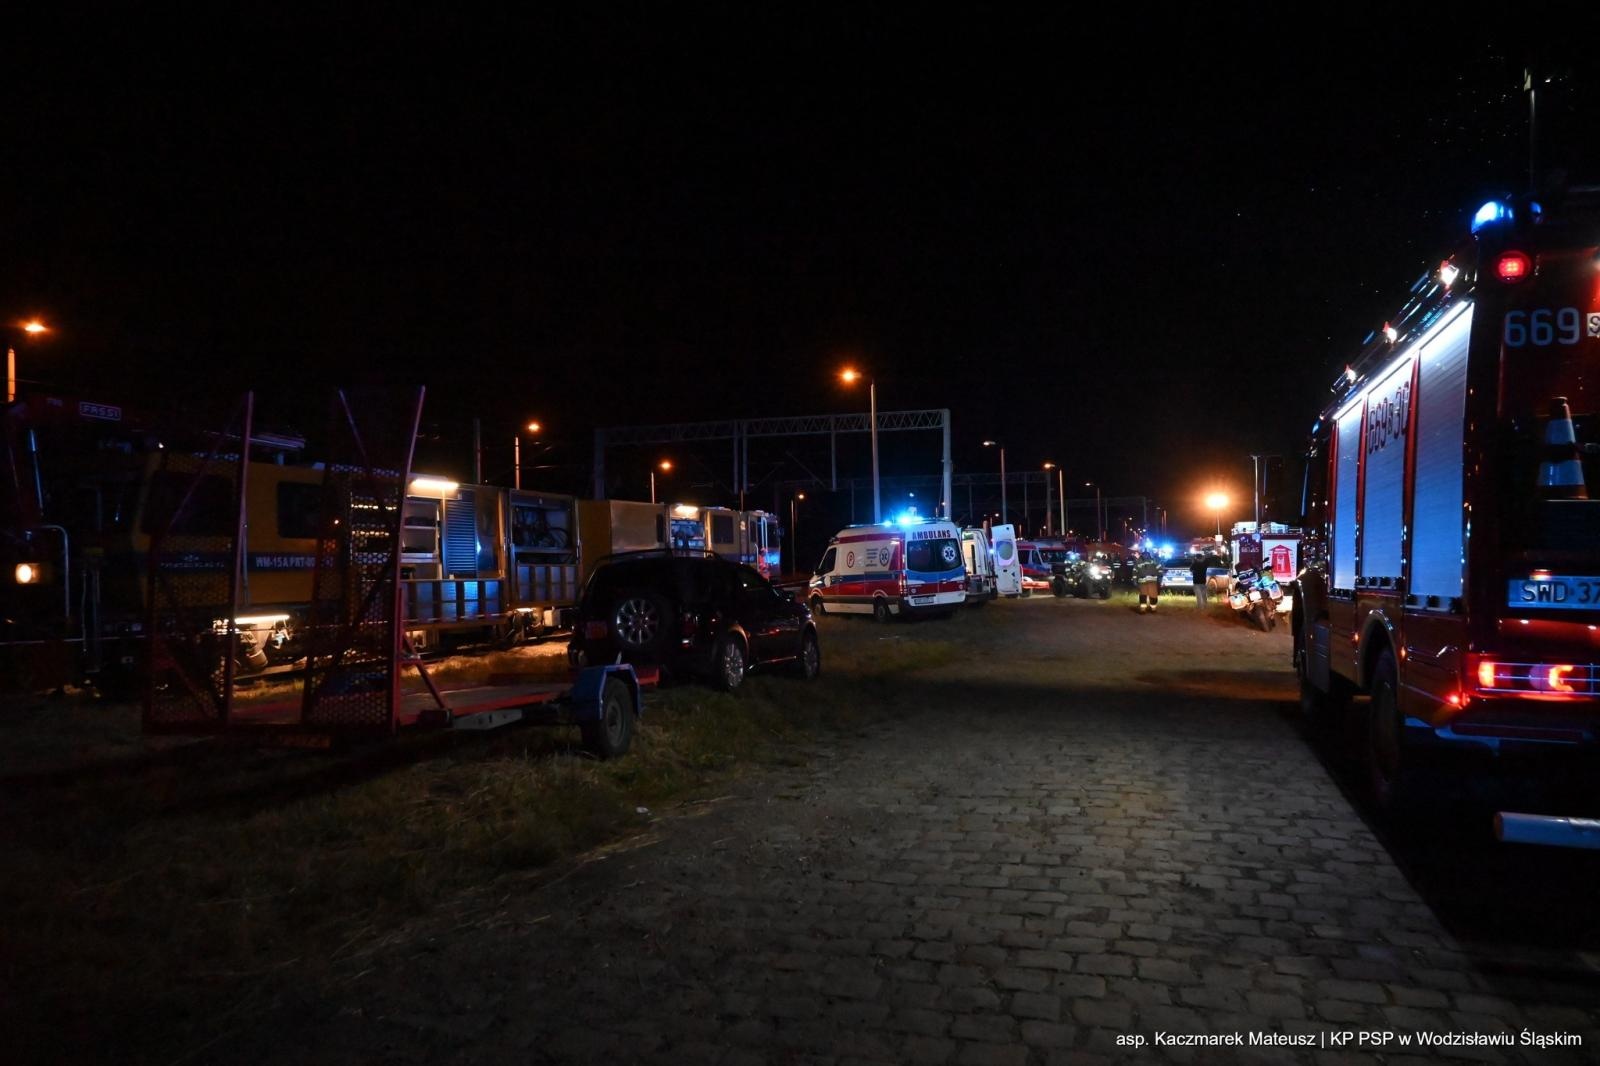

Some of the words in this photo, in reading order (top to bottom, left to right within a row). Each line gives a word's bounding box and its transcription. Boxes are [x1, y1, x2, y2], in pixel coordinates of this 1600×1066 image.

[1504, 306, 1580, 348] 669
[912, 529, 951, 540] AMBULANS
[1521, 581, 1569, 603] SWD
